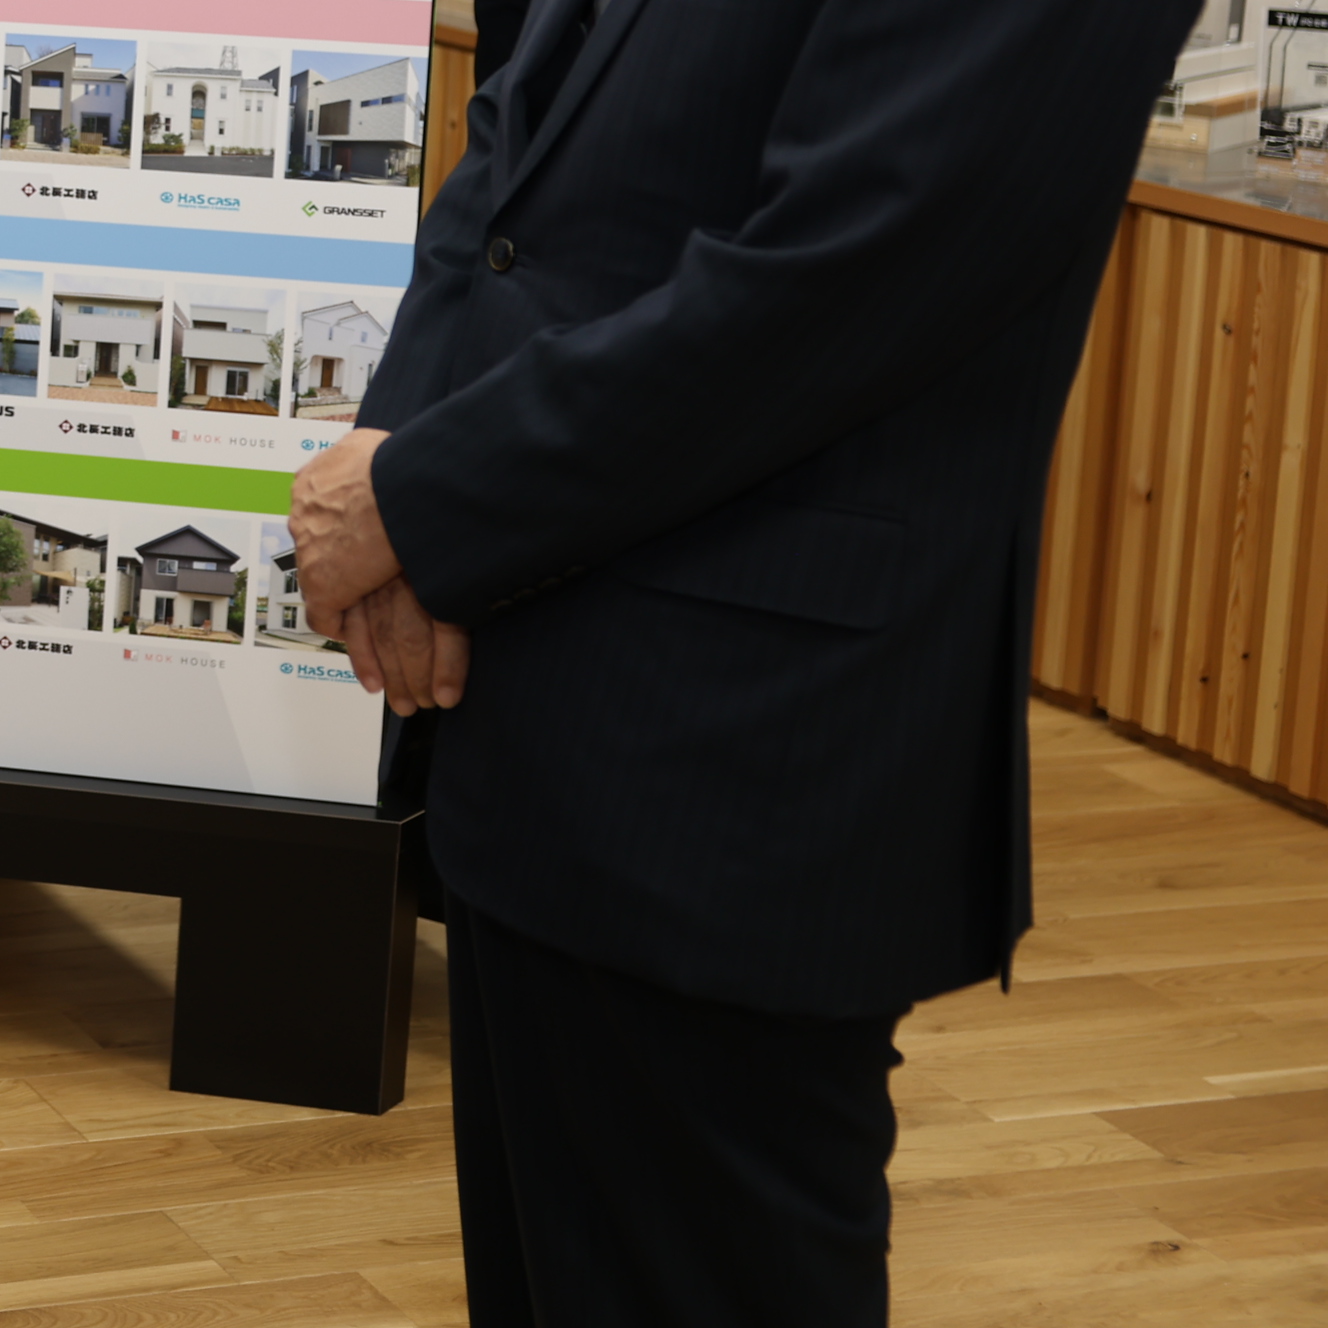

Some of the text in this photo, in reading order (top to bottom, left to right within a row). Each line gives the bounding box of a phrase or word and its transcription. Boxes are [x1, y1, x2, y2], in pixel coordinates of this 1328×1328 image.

[207, 196, 241, 208] casa
[323, 205, 386, 219] GRANSSET
[193, 433, 276, 450] MOK HOUSE
[144, 653, 226, 669] MOK HOUSE
